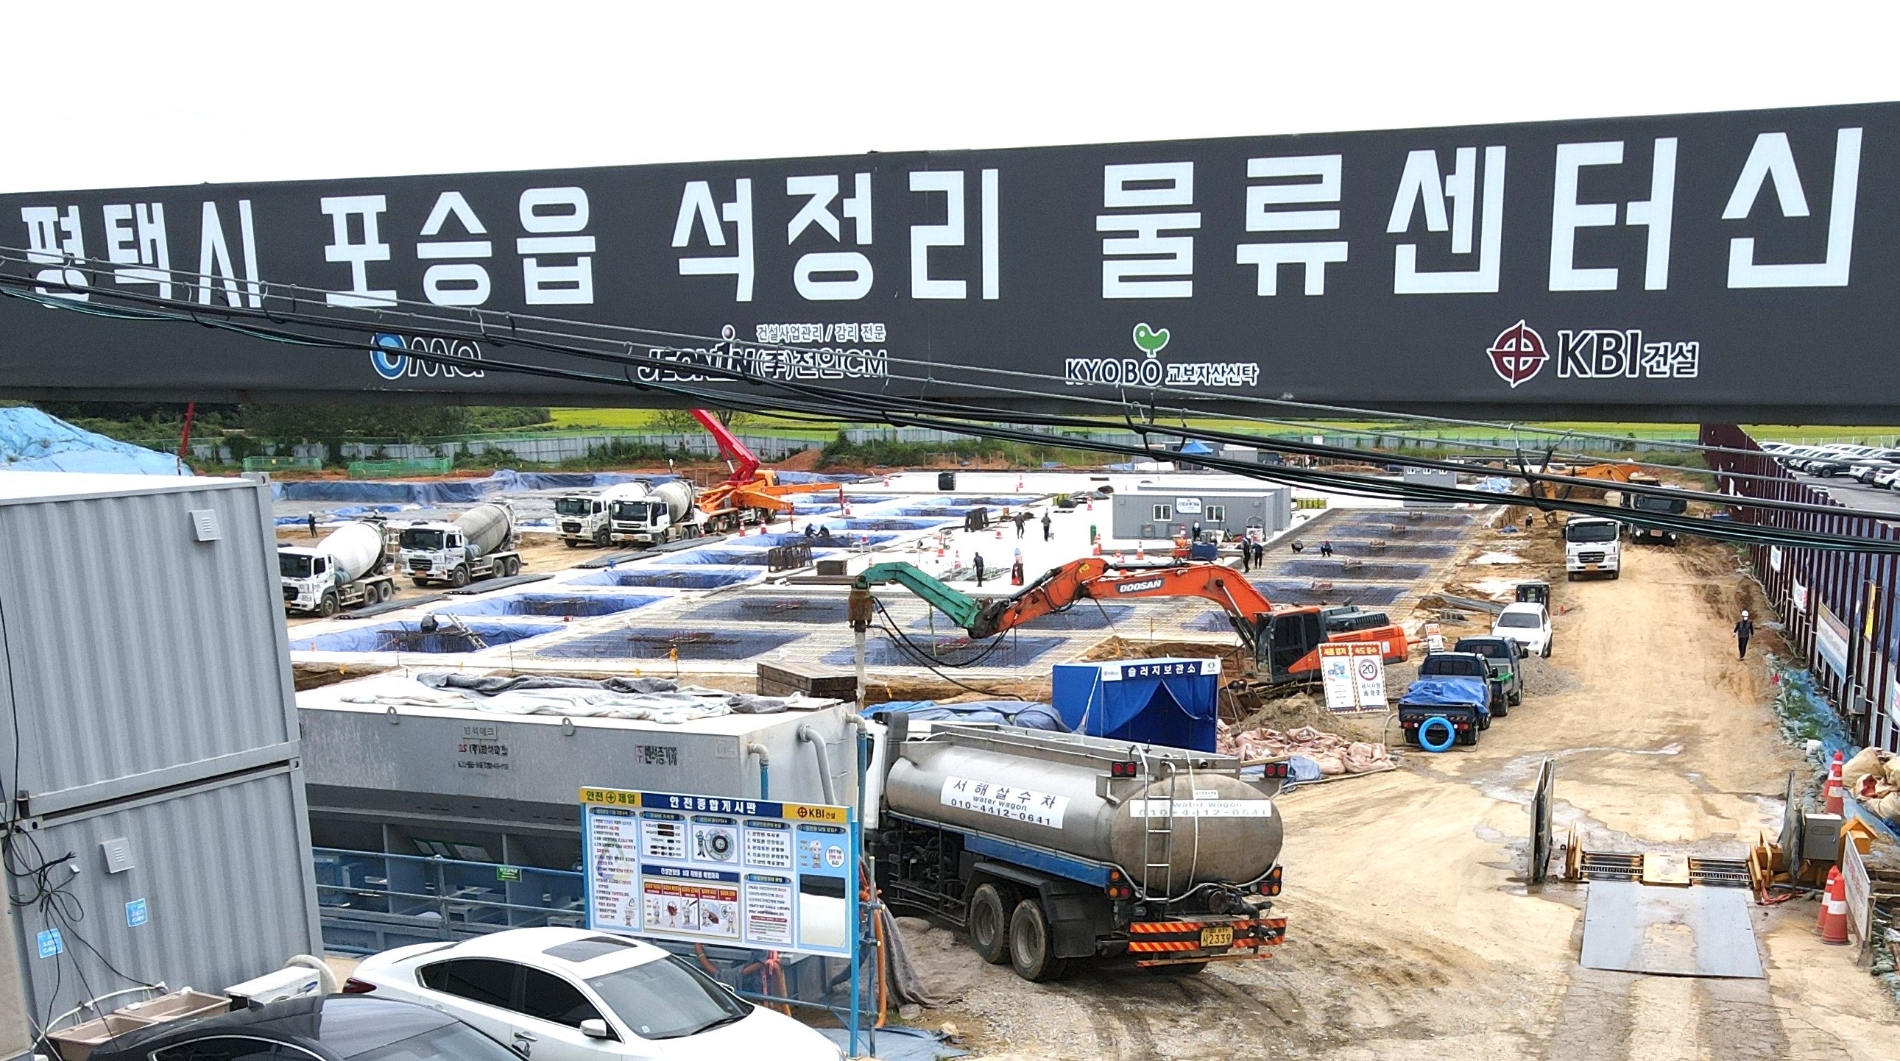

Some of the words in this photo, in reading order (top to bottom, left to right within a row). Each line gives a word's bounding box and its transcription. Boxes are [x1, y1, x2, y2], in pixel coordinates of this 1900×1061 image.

[21, 199, 263, 309] 평택시
[320, 186, 596, 308] 포승읍
[671, 168, 999, 302] 석정리
[756, 324, 823, 343] 건설사업관리
[835, 323, 859, 343] 감리
[861, 323, 887, 343] 전문
[1065, 358, 1163, 386] KYOBO
[1165, 362, 1260, 386] 교보자산신탁
[1119, 579, 1162, 593] DOOSAN
[1362, 664, 1375, 675] 20
[586, 790, 604, 802] 안전
[972, 794, 996, 806] water
[998, 799, 1027, 812] wagon
[950, 798, 1051, 826] 010-4412-0641
